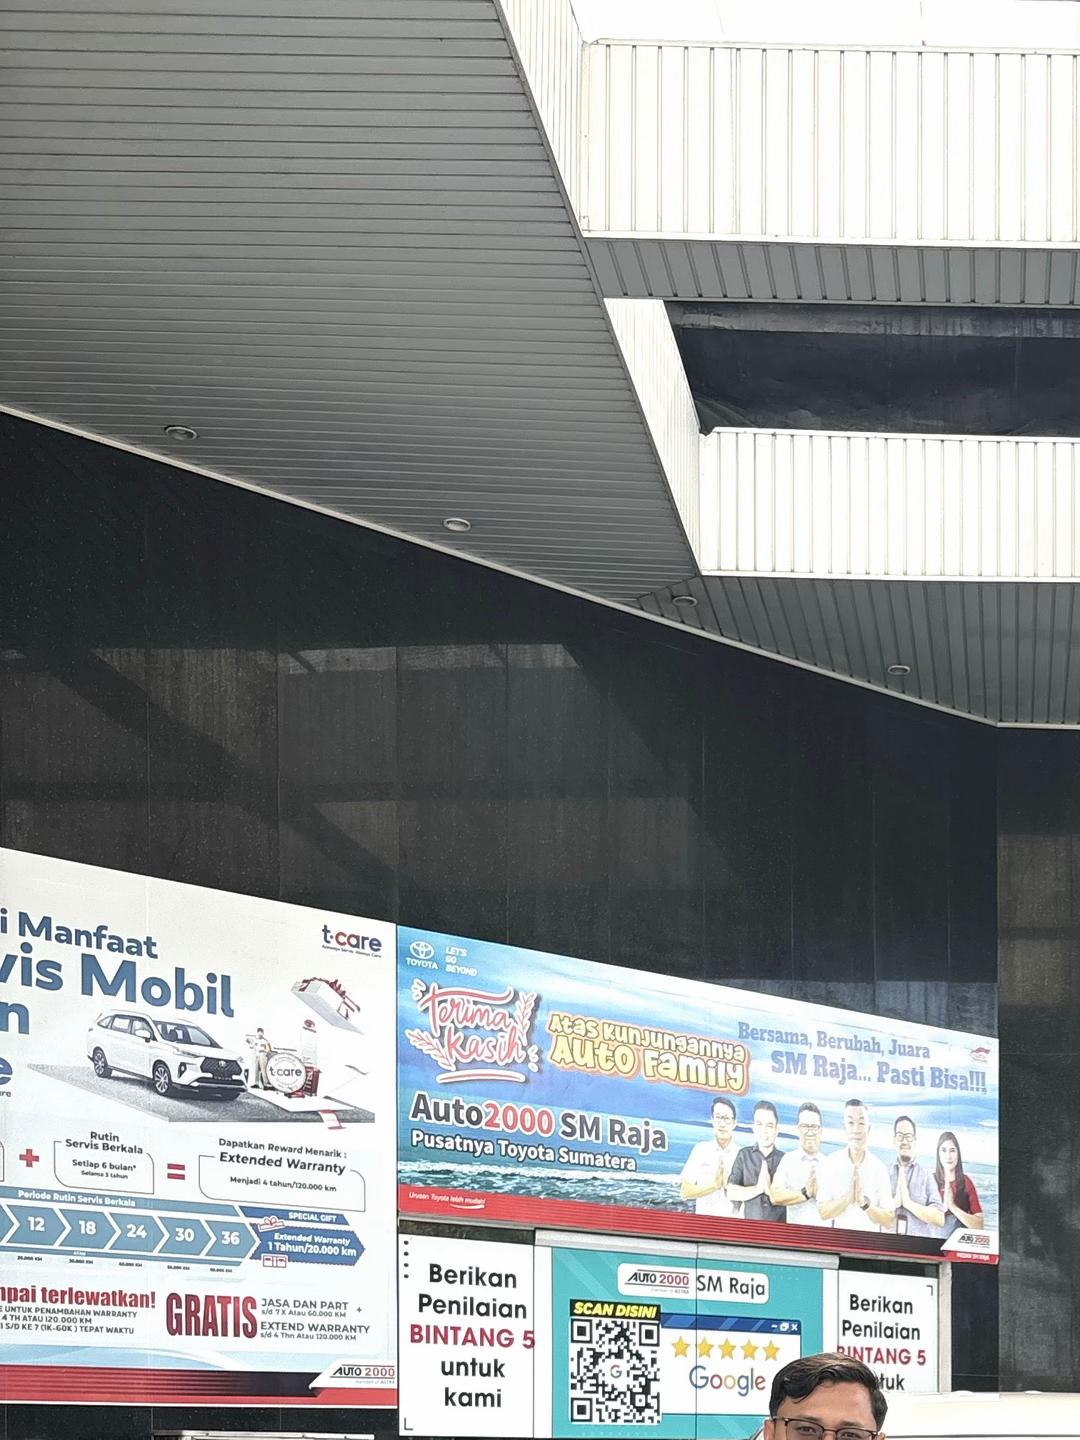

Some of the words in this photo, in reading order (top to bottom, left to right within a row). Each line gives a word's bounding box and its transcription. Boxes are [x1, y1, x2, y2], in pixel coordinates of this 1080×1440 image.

[19, 912, 158, 959] Manfaat
[445, 946, 467, 957] LET'S
[406, 957, 438, 970] TOYOTA
[445, 965, 478, 976] BEYOND
[81, 953, 234, 1017] Mobil
[549, 1014, 599, 1038] Atas
[738, 1021, 812, 1049] Bersama,
[816, 1030, 885, 1055] Berubah,
[887, 1039, 931, 1059] Juara
[550, 1035, 635, 1074] Auto
[643, 1049, 745, 1091] Family
[771, 1050, 807, 1075] SM
[813, 1054, 871, 1086] Raja...
[876, 1061, 925, 1087] Pasti
[930, 1067, 987, 1093] Bisa!!!
[411, 1092, 553, 1135] Auto2000
[560, 1112, 600, 1141] SM
[609, 1117, 667, 1152] Raja
[65, 1139, 99, 1150] Servis
[102, 1143, 143, 1154] Berkala
[90, 1131, 119, 1142] Rutin
[219, 1138, 265, 1150] Dapatkan
[268, 1143, 303, 1154] Reward
[305, 1146, 341, 1158] Menarik
[411, 1130, 494, 1155] Pusatnya
[498, 1139, 554, 1162] Toyota
[559, 1147, 636, 1171] Sumatera
[72, 1159, 100, 1170] Setiap
[219, 1152, 282, 1167] Extended
[287, 1158, 346, 1176] Warranty
[230, 1176, 261, 1186] Menjadi
[270, 1180, 323, 1191] tahun/120.000
[325, 1184, 337, 1192] km
[18, 1190, 51, 1200] Periode
[53, 1193, 76, 1202] Rutin
[78, 1195, 102, 1204] Servis
[105, 1197, 136, 1207] Berkala
[288, 1212, 319, 1221] SPECIAL
[321, 1214, 337, 1222] GIFT
[27, 1216, 45, 1231] 12
[79, 1220, 96, 1235] 18
[126, 1224, 147, 1239] 24
[175, 1227, 195, 1242] 30
[222, 1231, 240, 1245] 36
[274, 1232, 312, 1243] Extended
[314, 1235, 351, 1246] Warranty
[275, 1242, 339, 1255] Tahun/20.000
[341, 1247, 357, 1257] km
[429, 1263, 517, 1288] Berikan
[627, 1272, 657, 1283] AUTO
[659, 1274, 689, 1286] 2000
[696, 1275, 723, 1294] SM
[729, 1277, 766, 1300] Raja
[41, 1287, 156, 1308] terlewatkan!
[262, 1298, 290, 1308] JASA
[293, 1299, 317, 1309] DAN
[320, 1301, 349, 1310] PART
[418, 1293, 527, 1319] Penilaian
[850, 1294, 913, 1315] Berikan
[5, 1306, 33, 1314] UNTUK
[35, 1307, 91, 1316] PENAMBAHAN
[93, 1310, 138, 1318] WARRANTY
[166, 1292, 258, 1339] GRATIS
[573, 1302, 614, 1317] SCAN
[616, 1303, 657, 1319] DISINI
[106, 1327, 135, 1335] WAKTU
[260, 1321, 304, 1331] EXTEND
[308, 1323, 370, 1334] WARRANTY
[410, 1323, 514, 1349] BINTANG
[522, 1330, 535, 1350] 5
[842, 1319, 920, 1341] Penilaian
[441, 1357, 506, 1378] untuk
[917, 1350, 927, 1366] 5
[333, 1366, 362, 1377] AUTO
[365, 1367, 395, 1377] 2000
[689, 1365, 766, 1397] Google
[444, 1387, 502, 1407] kami
